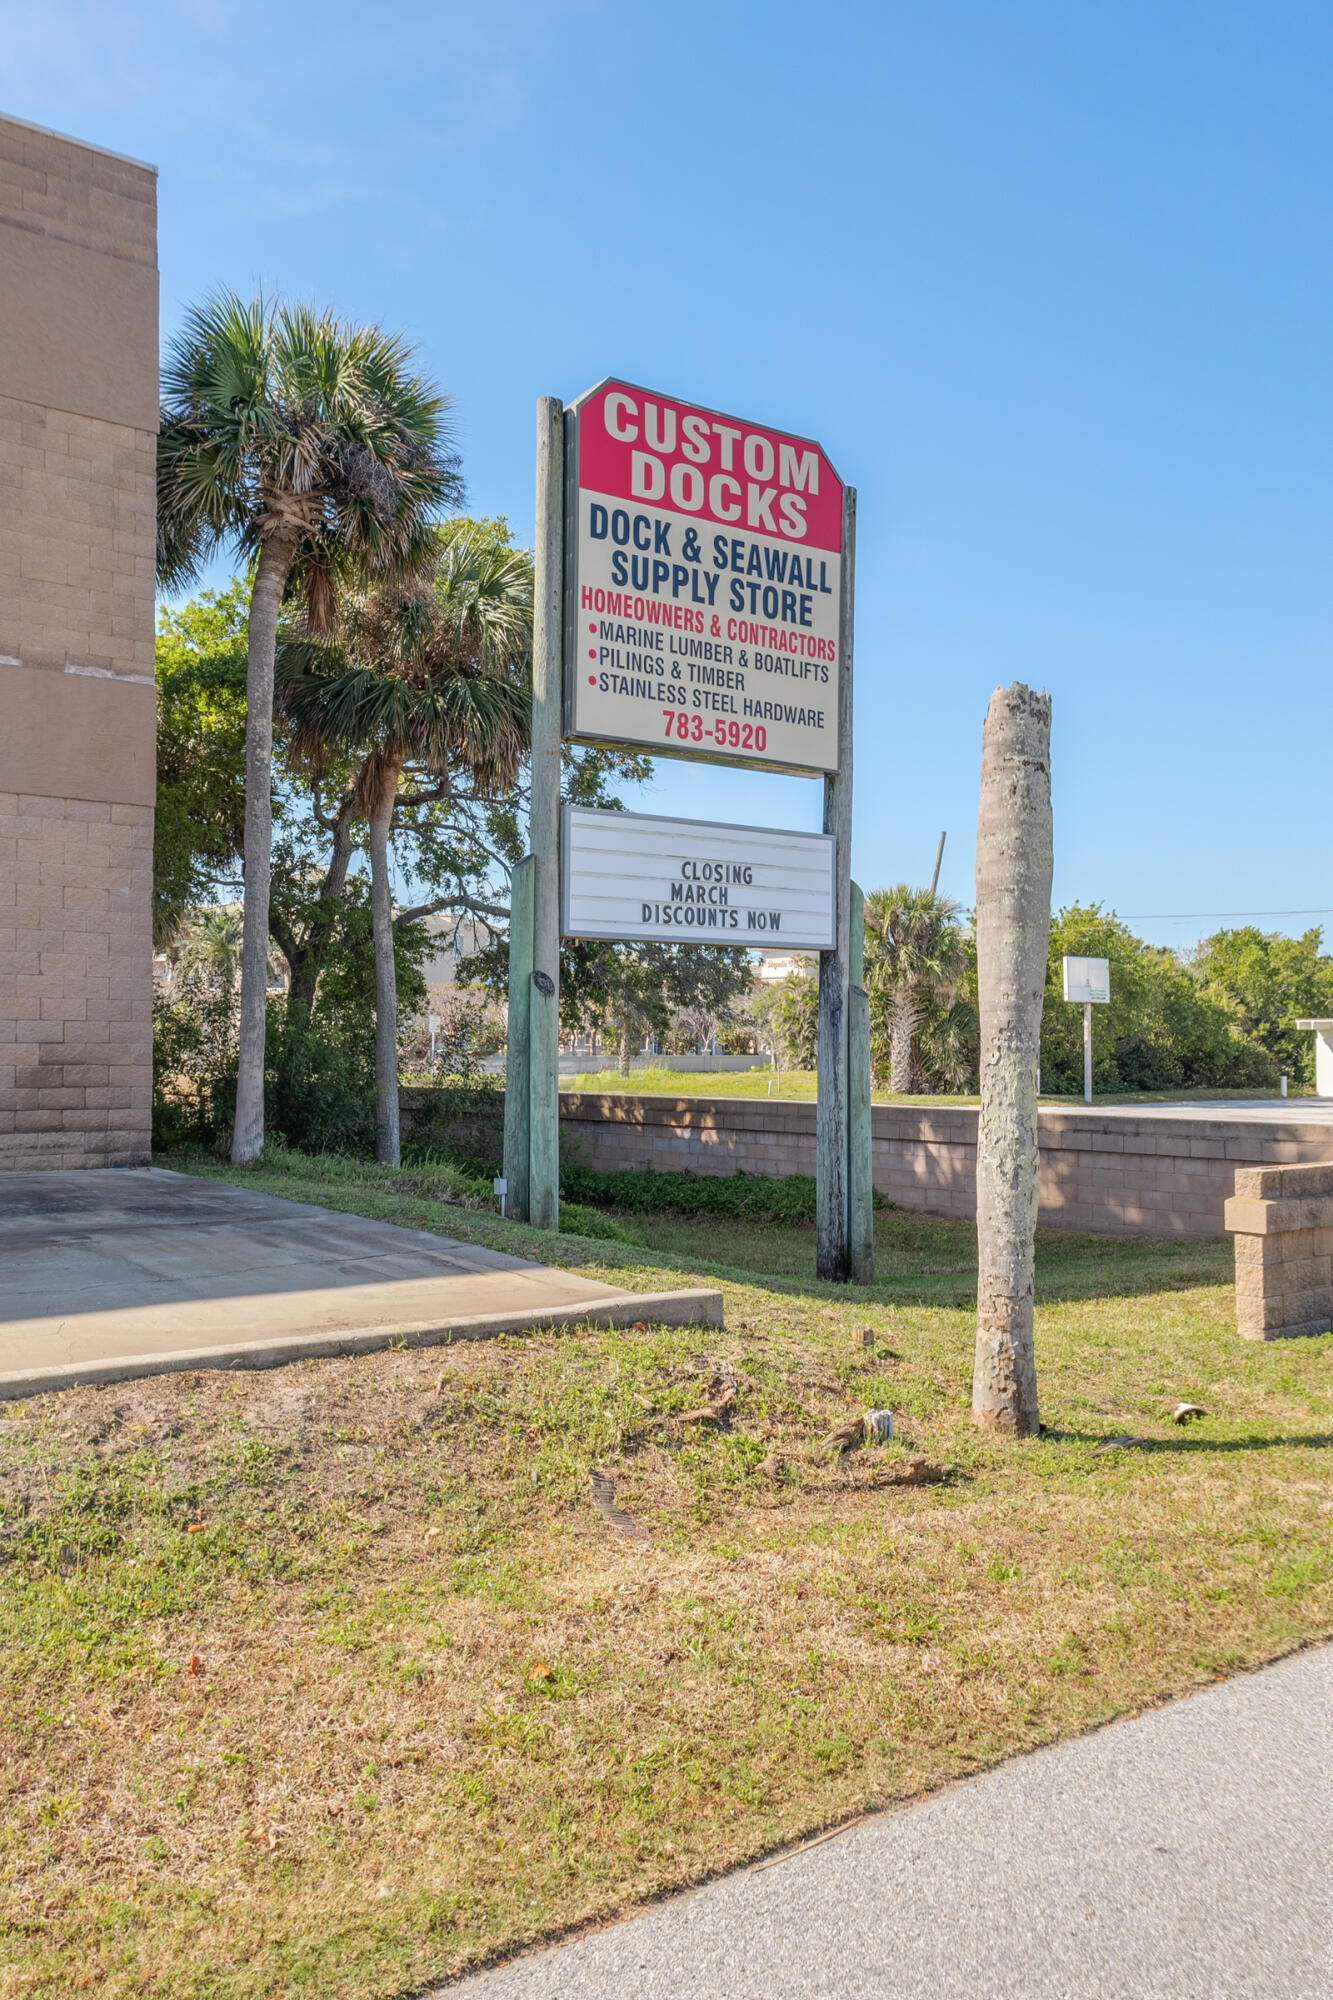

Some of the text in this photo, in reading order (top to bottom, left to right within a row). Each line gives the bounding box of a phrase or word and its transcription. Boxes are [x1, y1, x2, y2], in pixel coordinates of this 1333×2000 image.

[604, 392, 819, 495] CUSTOM
[631, 450, 807, 538] DOCKS
[590, 503, 832, 594] DOCK & SEAWALL
[611, 550, 813, 627] SUPPLY STORE
[581, 585, 836, 662] HOMEOWNERS & CONTRACTORS
[600, 621, 829, 683] MARINE LUMBER & BOATLIFTS
[600, 647, 745, 691] PILINGS & TIMBER
[599, 672, 824, 729] STAINLESS STEEL HARDWARE
[662, 710, 767, 752] 783-5920
[671, 883, 728, 905] MARCH
[681, 861, 753, 884] CLOSING
[642, 904, 781, 930] DISCOUNTS NOW
